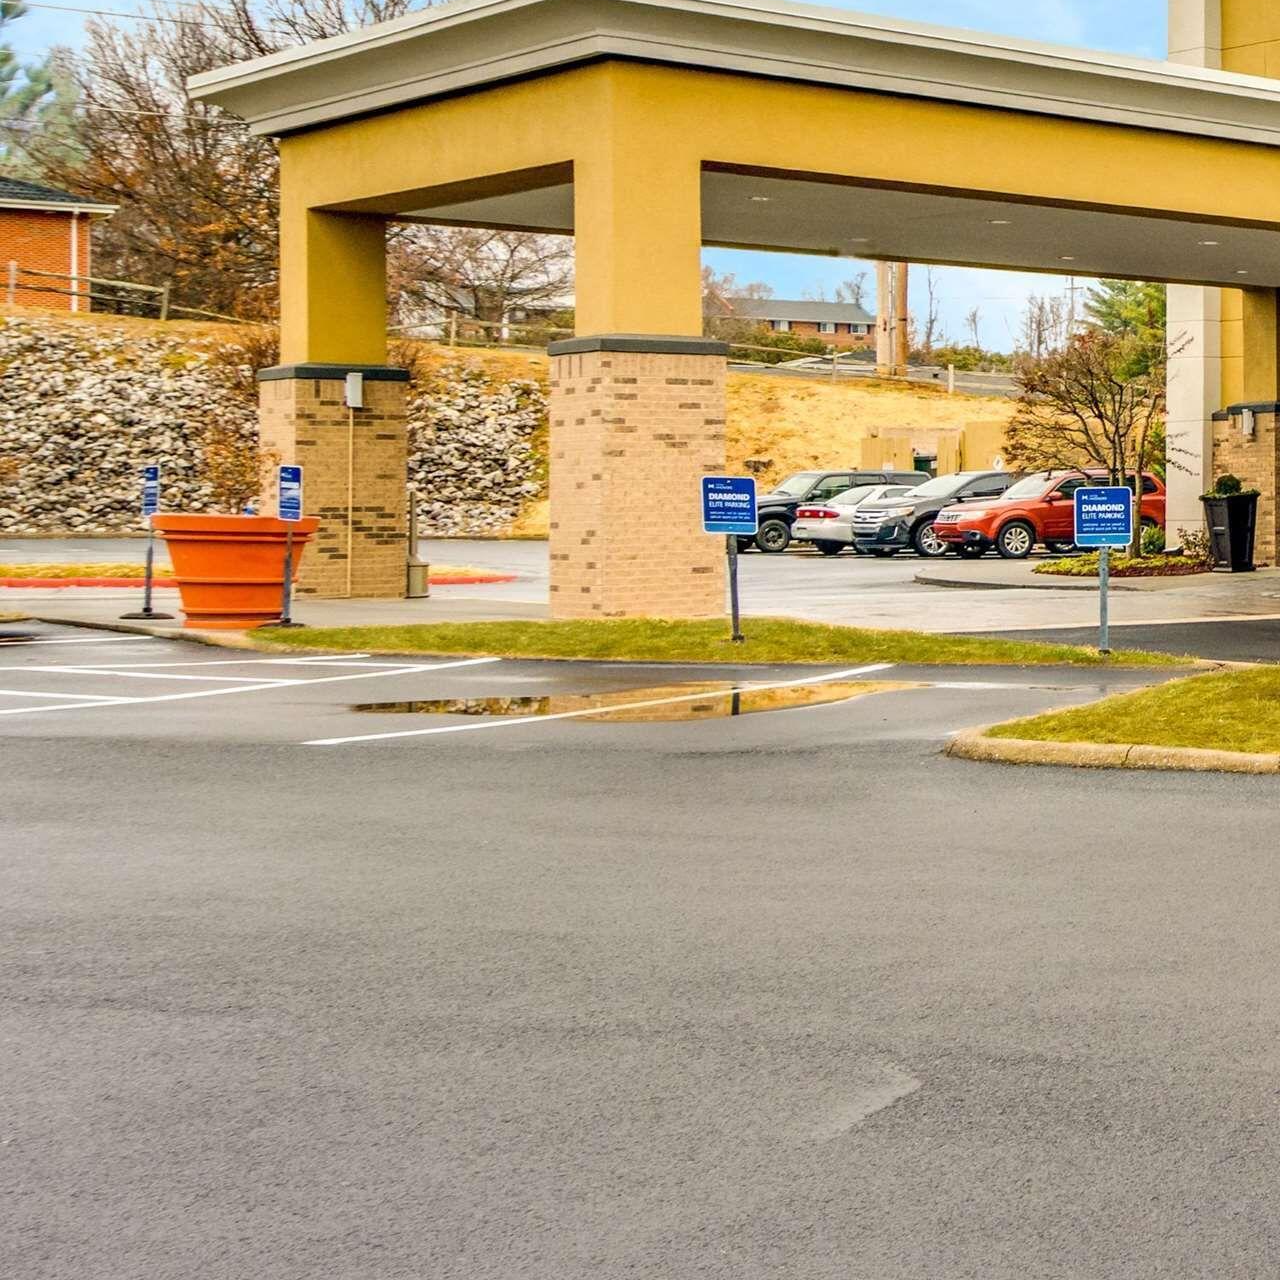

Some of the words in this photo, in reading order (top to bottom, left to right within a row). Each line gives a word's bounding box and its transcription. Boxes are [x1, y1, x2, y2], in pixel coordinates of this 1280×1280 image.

[708, 492, 750, 501] DIAMOND
[1082, 504, 1125, 512] DIAMOND
[1081, 512, 1097, 520] ELITE
